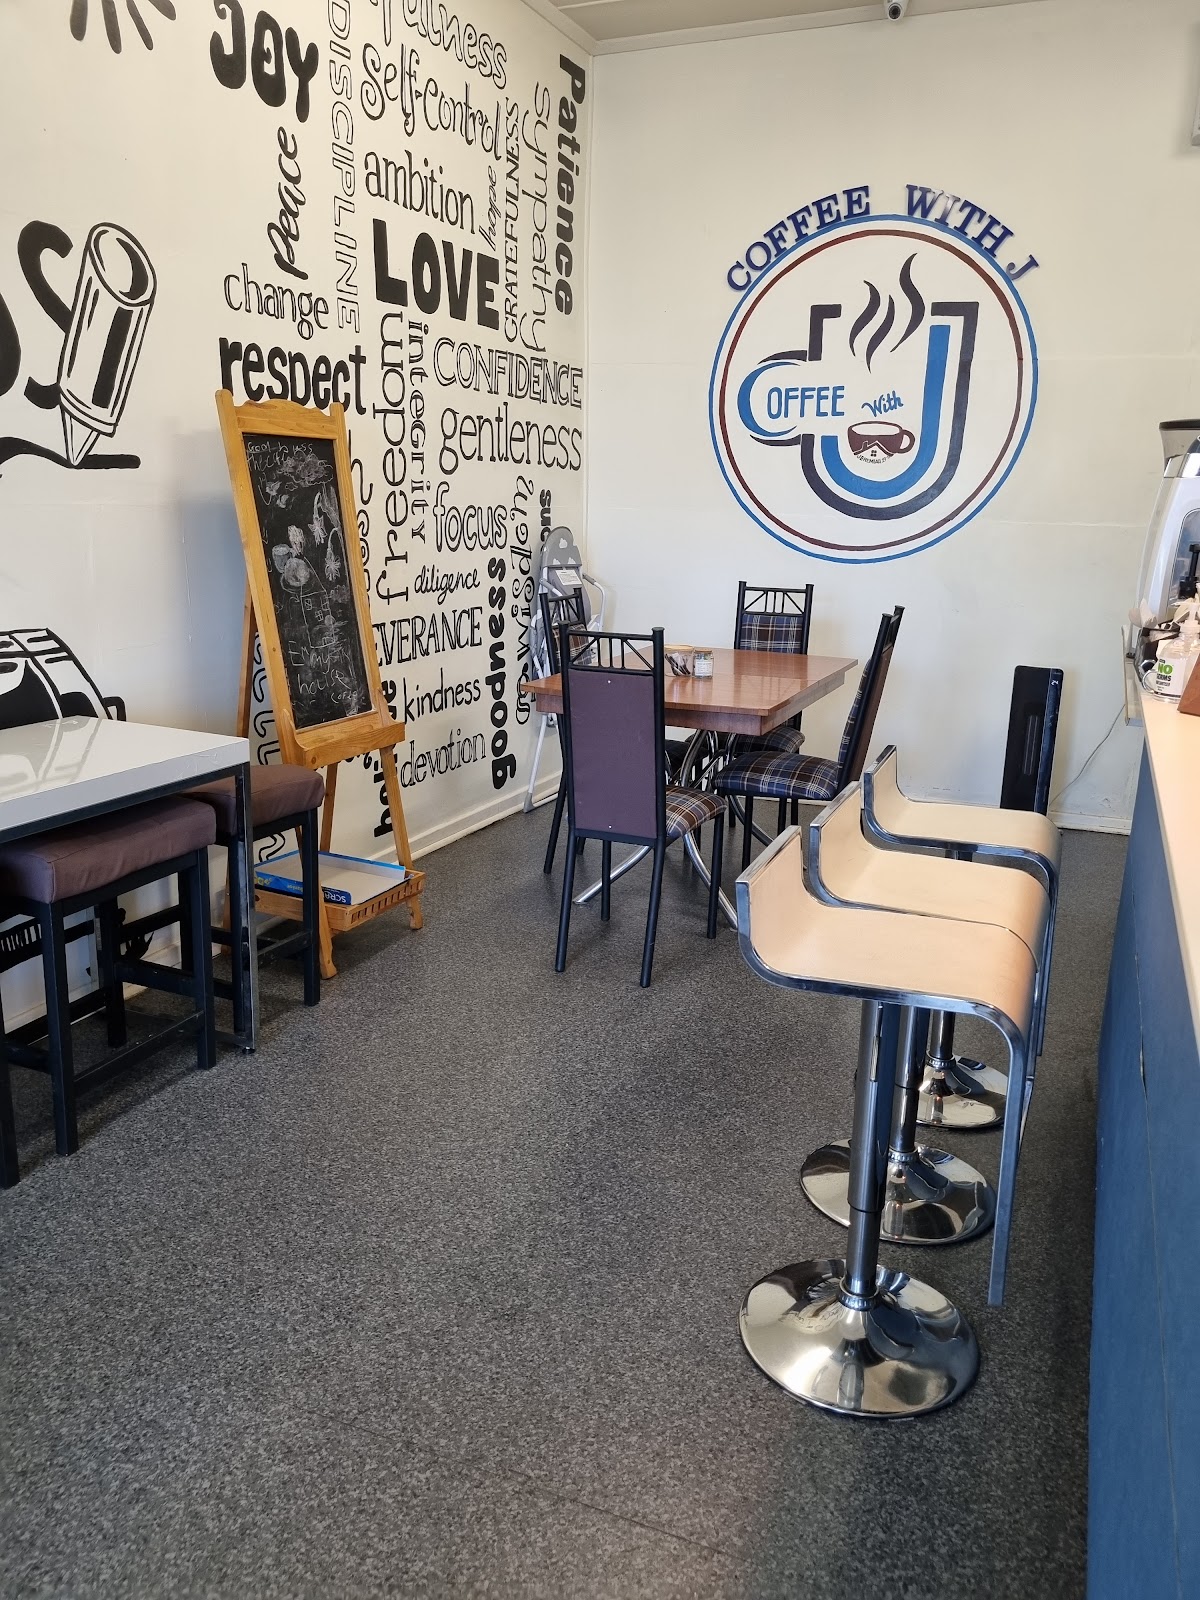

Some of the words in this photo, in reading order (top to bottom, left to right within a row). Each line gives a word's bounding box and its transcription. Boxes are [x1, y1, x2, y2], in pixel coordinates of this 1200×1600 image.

[210, 0, 319, 123] JOY
[267, 126, 309, 281] peace
[328, 0, 360, 334] DISCIPLINE
[364, 150, 476, 235] ambition
[478, 165, 502, 252] hope
[554, 54, 586, 316] Patience
[504, 97, 519, 342] GRATEFULNESS
[726, 185, 871, 291] COFFEE
[905, 184, 1015, 258] WITH
[1007, 254, 1039, 281] J
[223, 262, 330, 341] change
[372, 218, 500, 330] LOVE
[218, 337, 367, 416] respect
[433, 337, 583, 410] CONFIDENCE
[861, 390, 904, 417] With
[372, 311, 409, 606] freedom
[438, 401, 583, 476] gentleness
[432, 481, 508, 553] focus
[414, 564, 481, 606] diligence
[402, 667, 482, 725] kindness
[485, 557, 516, 790] goodness
[400, 728, 487, 789] devotion
